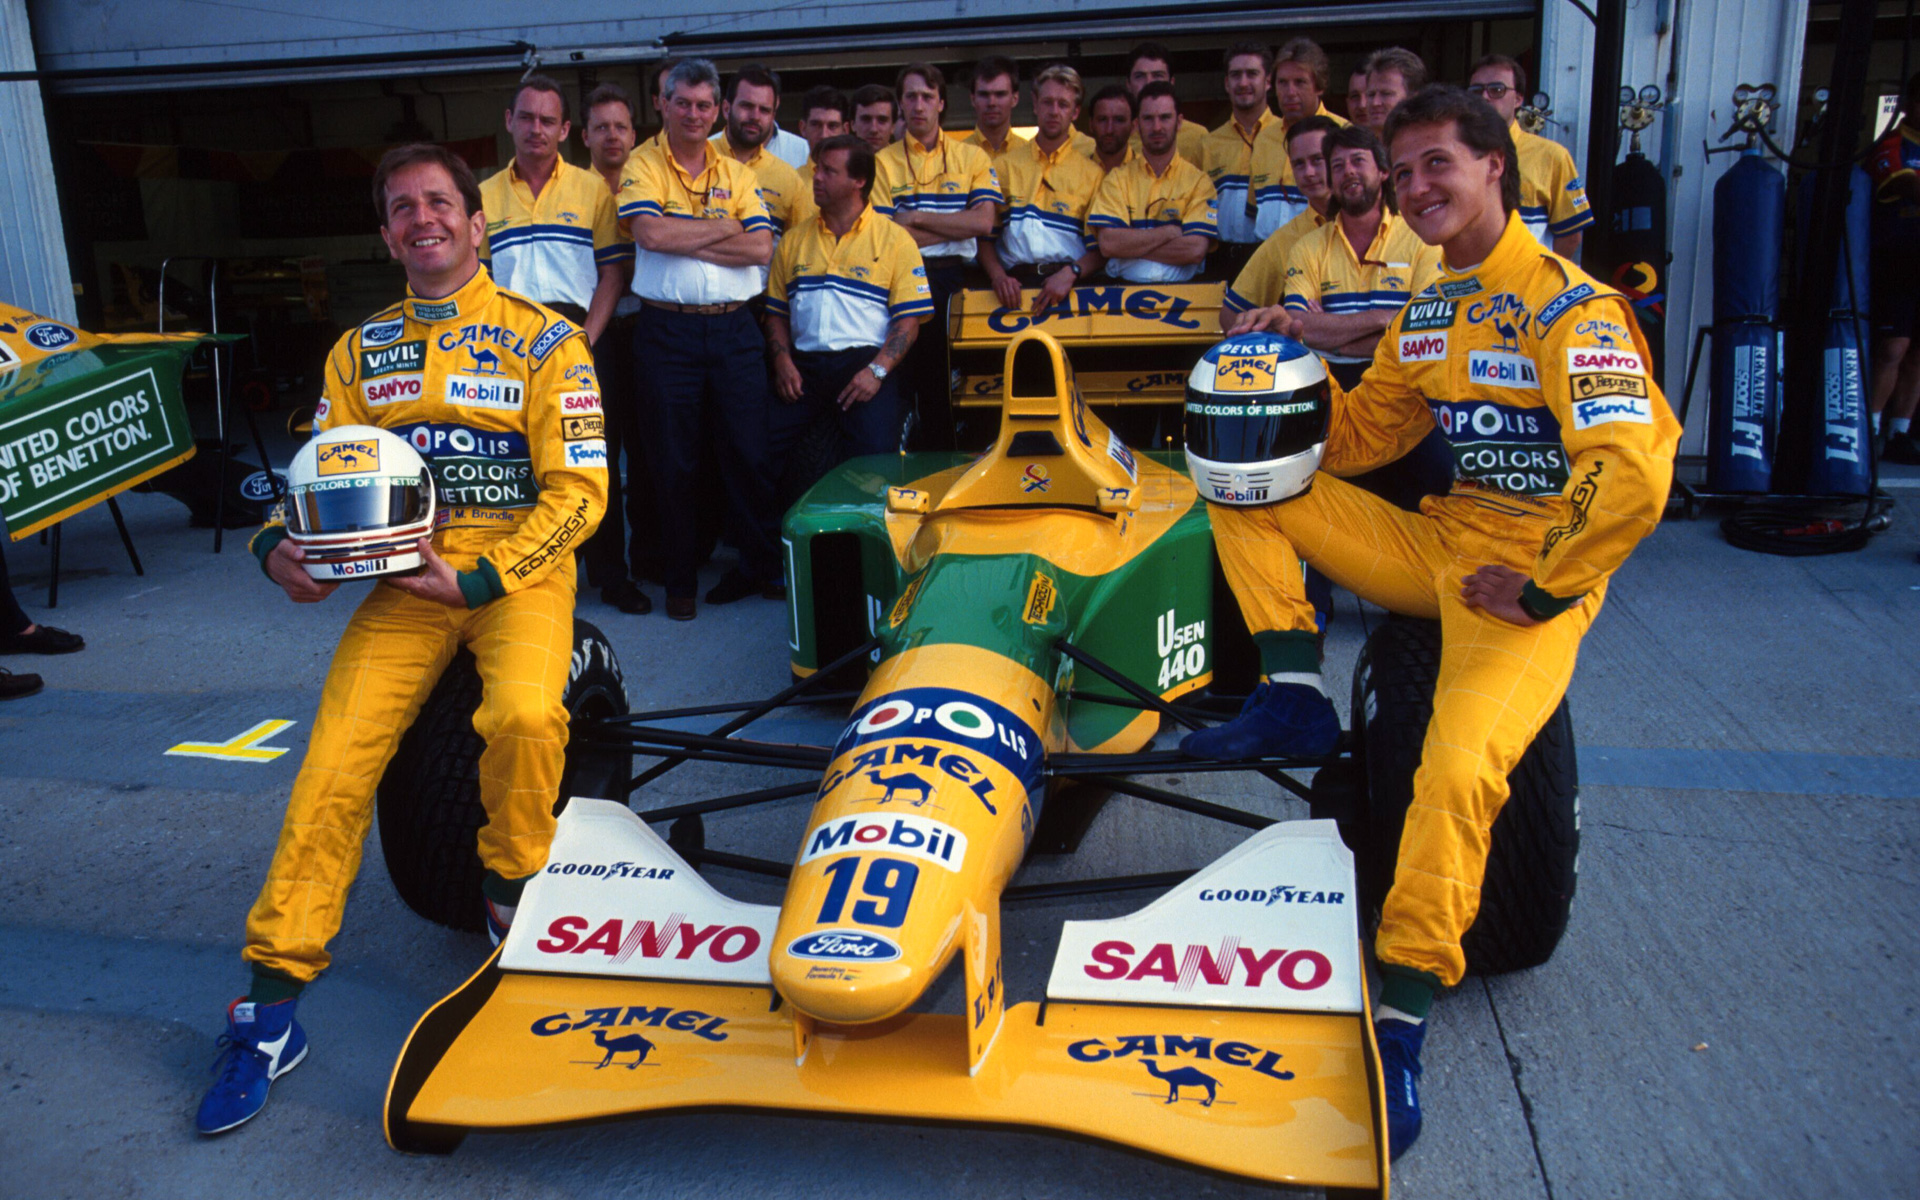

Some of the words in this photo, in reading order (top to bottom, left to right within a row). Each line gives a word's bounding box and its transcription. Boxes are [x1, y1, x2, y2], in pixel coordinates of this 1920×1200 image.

[988, 287, 1201, 334] CAMEL
[1410, 301, 1453, 321] VIVIL
[438, 324, 528, 359] CAMEL
[532, 321, 571, 357] sparco
[1402, 336, 1445, 359] SANYO
[1575, 320, 1633, 344] CAMEL
[1219, 343, 1281, 355] DEKRA
[1573, 353, 1638, 369] SANYO
[1127, 373, 1188, 392] CAM
[1218, 359, 1276, 376] CAMEL
[1472, 359, 1516, 381] Mobil
[1753, 346, 1767, 418] RENAULT
[368, 378, 421, 401] SANYO
[450, 381, 500, 402] Mobil
[1846, 348, 1859, 421] RENAULT
[1204, 404, 1243, 416] COLORS
[1246, 405, 1262, 416] OF
[1433, 404, 1539, 435] TOPOLIS
[0, 428, 60, 470] NITED
[66, 390, 150, 441] COLORS
[1732, 418, 1763, 460] F1
[1826, 421, 1859, 463] F1
[29, 419, 152, 488] BENETTON.
[319, 443, 377, 462] CAMEL
[1461, 449, 1560, 471] COLORS
[309, 479, 351, 492] COLORS
[355, 478, 371, 488] OF
[443, 463, 530, 482] COLORS
[1214, 488, 1254, 501] Mobil
[454, 509, 467, 519] M.
[472, 508, 515, 521] Brundle
[505, 497, 589, 581] TECHNOGYM
[331, 560, 374, 576] Mobil
[1157, 643, 1206, 690] 440
[845, 699, 1028, 761] TOPOLIS
[816, 743, 998, 816] CAMEL
[808, 819, 957, 862] Mobil
[815, 856, 920, 929] 19
[536, 912, 761, 964] SANYO
[808, 934, 878, 957] Ford
[1083, 935, 1333, 993] SANYO
[530, 1006, 729, 1041] CAMEL
[1067, 1035, 1296, 1081] CAMEL
